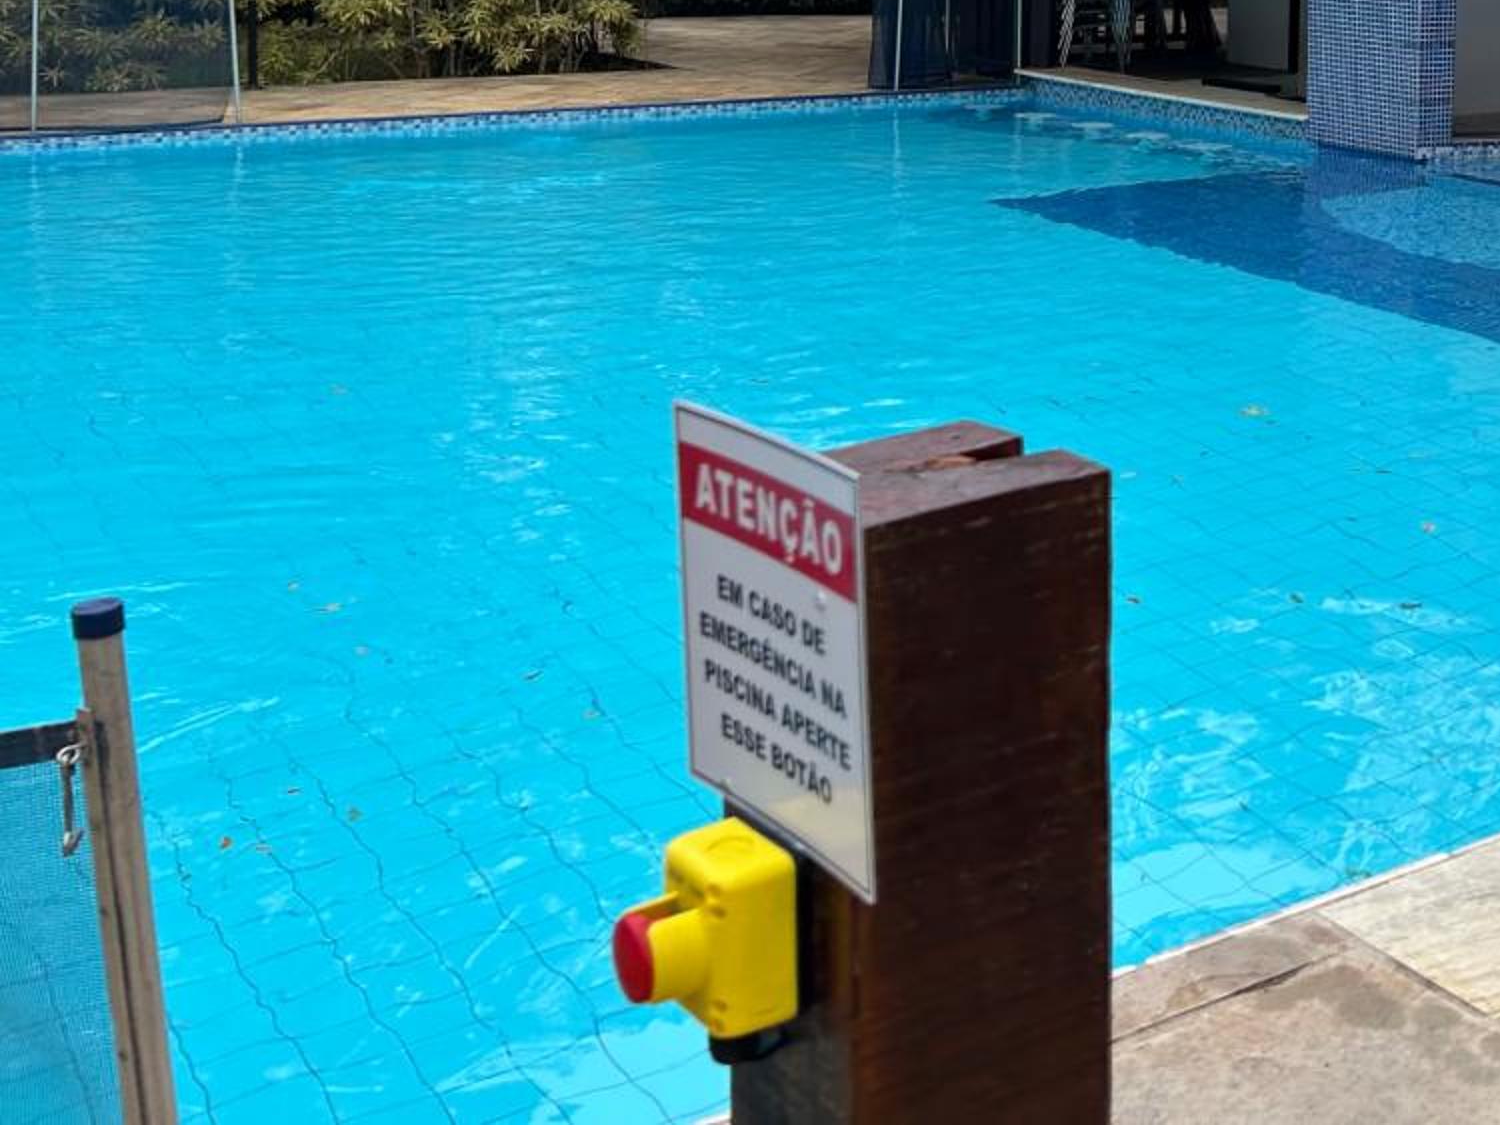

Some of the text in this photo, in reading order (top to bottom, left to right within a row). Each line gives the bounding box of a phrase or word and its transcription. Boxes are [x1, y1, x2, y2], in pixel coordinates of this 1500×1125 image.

[695, 463, 843, 575] ATENÇÃO
[699, 611, 846, 720] EMERGÊNCIA NA
[717, 573, 826, 654] EM CASO DE
[704, 658, 852, 771] PISCINA APERTE
[720, 713, 832, 804] ESSE BOTÃO
